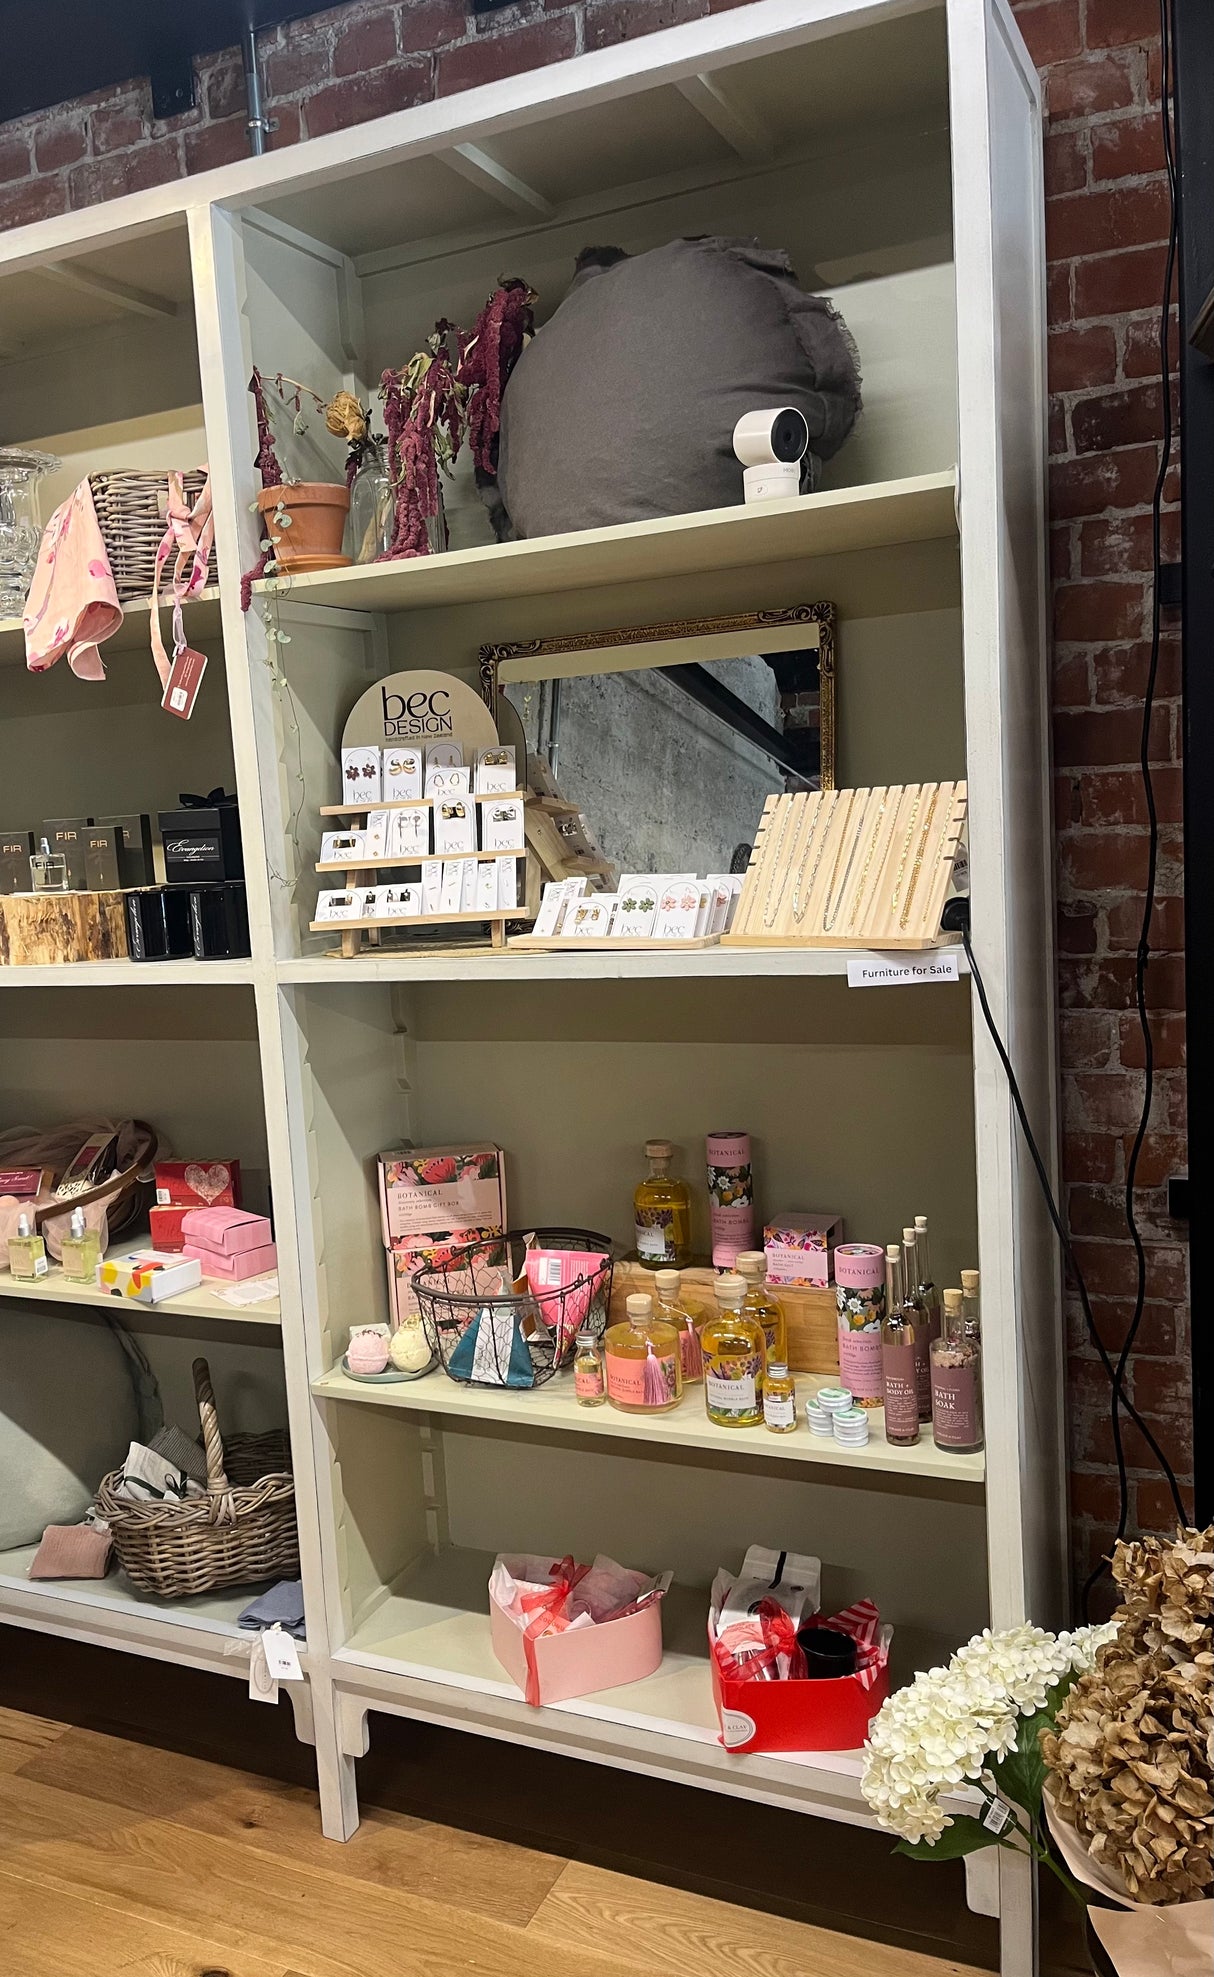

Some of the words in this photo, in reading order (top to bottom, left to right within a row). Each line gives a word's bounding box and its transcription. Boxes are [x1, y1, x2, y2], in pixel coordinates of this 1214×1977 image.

[381, 686, 451, 721] bec
[384, 715, 453, 737] DESIGN
[352, 789, 372, 799] bec
[55, 831, 77, 841] FIR
[3, 845, 22, 853] FIR
[89, 840, 108, 848] FIR
[862, 968, 910, 978] Furniture
[912, 966, 927, 975] for
[929, 965, 952, 974] Sale
[708, 1148, 744, 1156] BOTANICAL
[397, 1189, 443, 1199] BOTANICAL
[838, 1266, 880, 1275] BOTANICAL
[842, 1343, 858, 1351] BATH
[610, 1374, 641, 1385] BOTANICAL
[708, 1381, 745, 1391] BOTANICAL
[886, 1381, 904, 1389] BATH
[934, 1389, 956, 1400] BATH
[935, 1398, 955, 1410] SOAK
